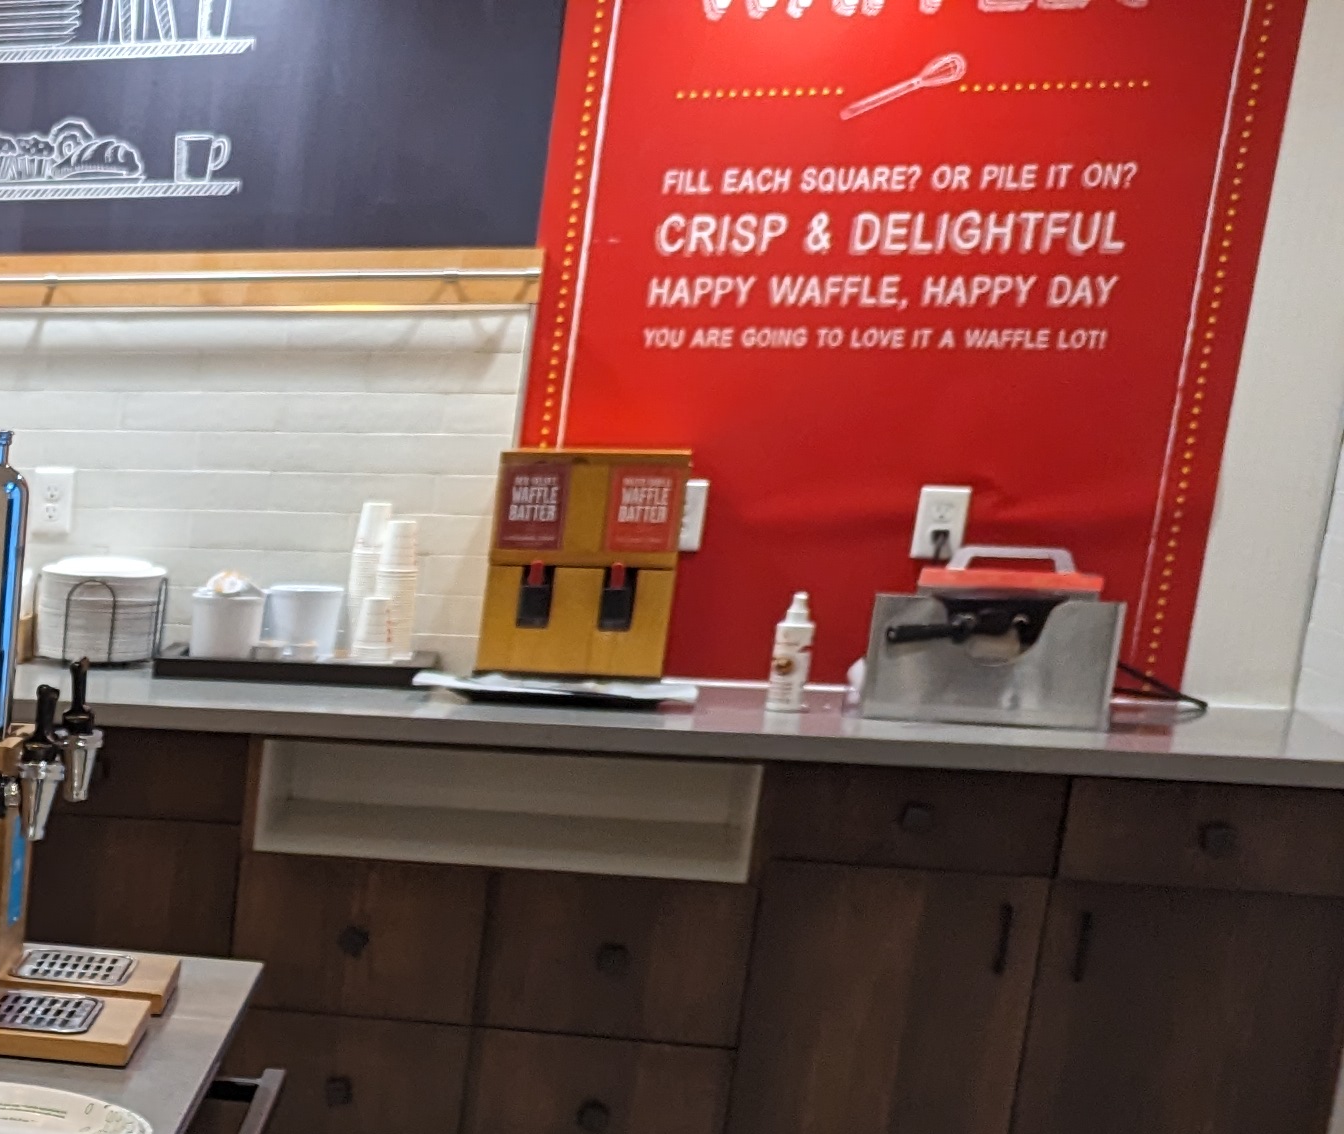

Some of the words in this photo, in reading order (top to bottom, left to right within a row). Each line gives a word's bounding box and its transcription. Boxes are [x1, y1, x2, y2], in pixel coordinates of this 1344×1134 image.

[662, 168, 711, 194] FILL
[721, 167, 791, 194] EACH
[801, 165, 921, 193] SQUARE?
[931, 164, 971, 191] OR
[980, 163, 1038, 190] PILE
[1046, 163, 1073, 190] IT
[1082, 161, 1138, 189] ON?
[656, 211, 788, 257] CRISP
[805, 211, 831, 254] &
[850, 209, 1126, 256] DELIGHTFUL
[647, 276, 758, 308] HAPPY
[770, 274, 910, 311] WAFFLE,
[921, 275, 1038, 308] HAPPY
[1047, 275, 1120, 308] DAY
[643, 326, 686, 348] YOU
[690, 326, 735, 348] ARE
[741, 325, 809, 348] GOING
[817, 325, 844, 348] TO
[850, 326, 906, 349] LOVE
[912, 328, 933, 348] IT
[938, 328, 956, 348] A
[964, 328, 1050, 349] WAFFLE
[512, 486, 559, 504] WAFFLE
[621, 488, 670, 505] WAFFLE
[508, 505, 557, 521] BATTER
[617, 506, 668, 523] BATTER
